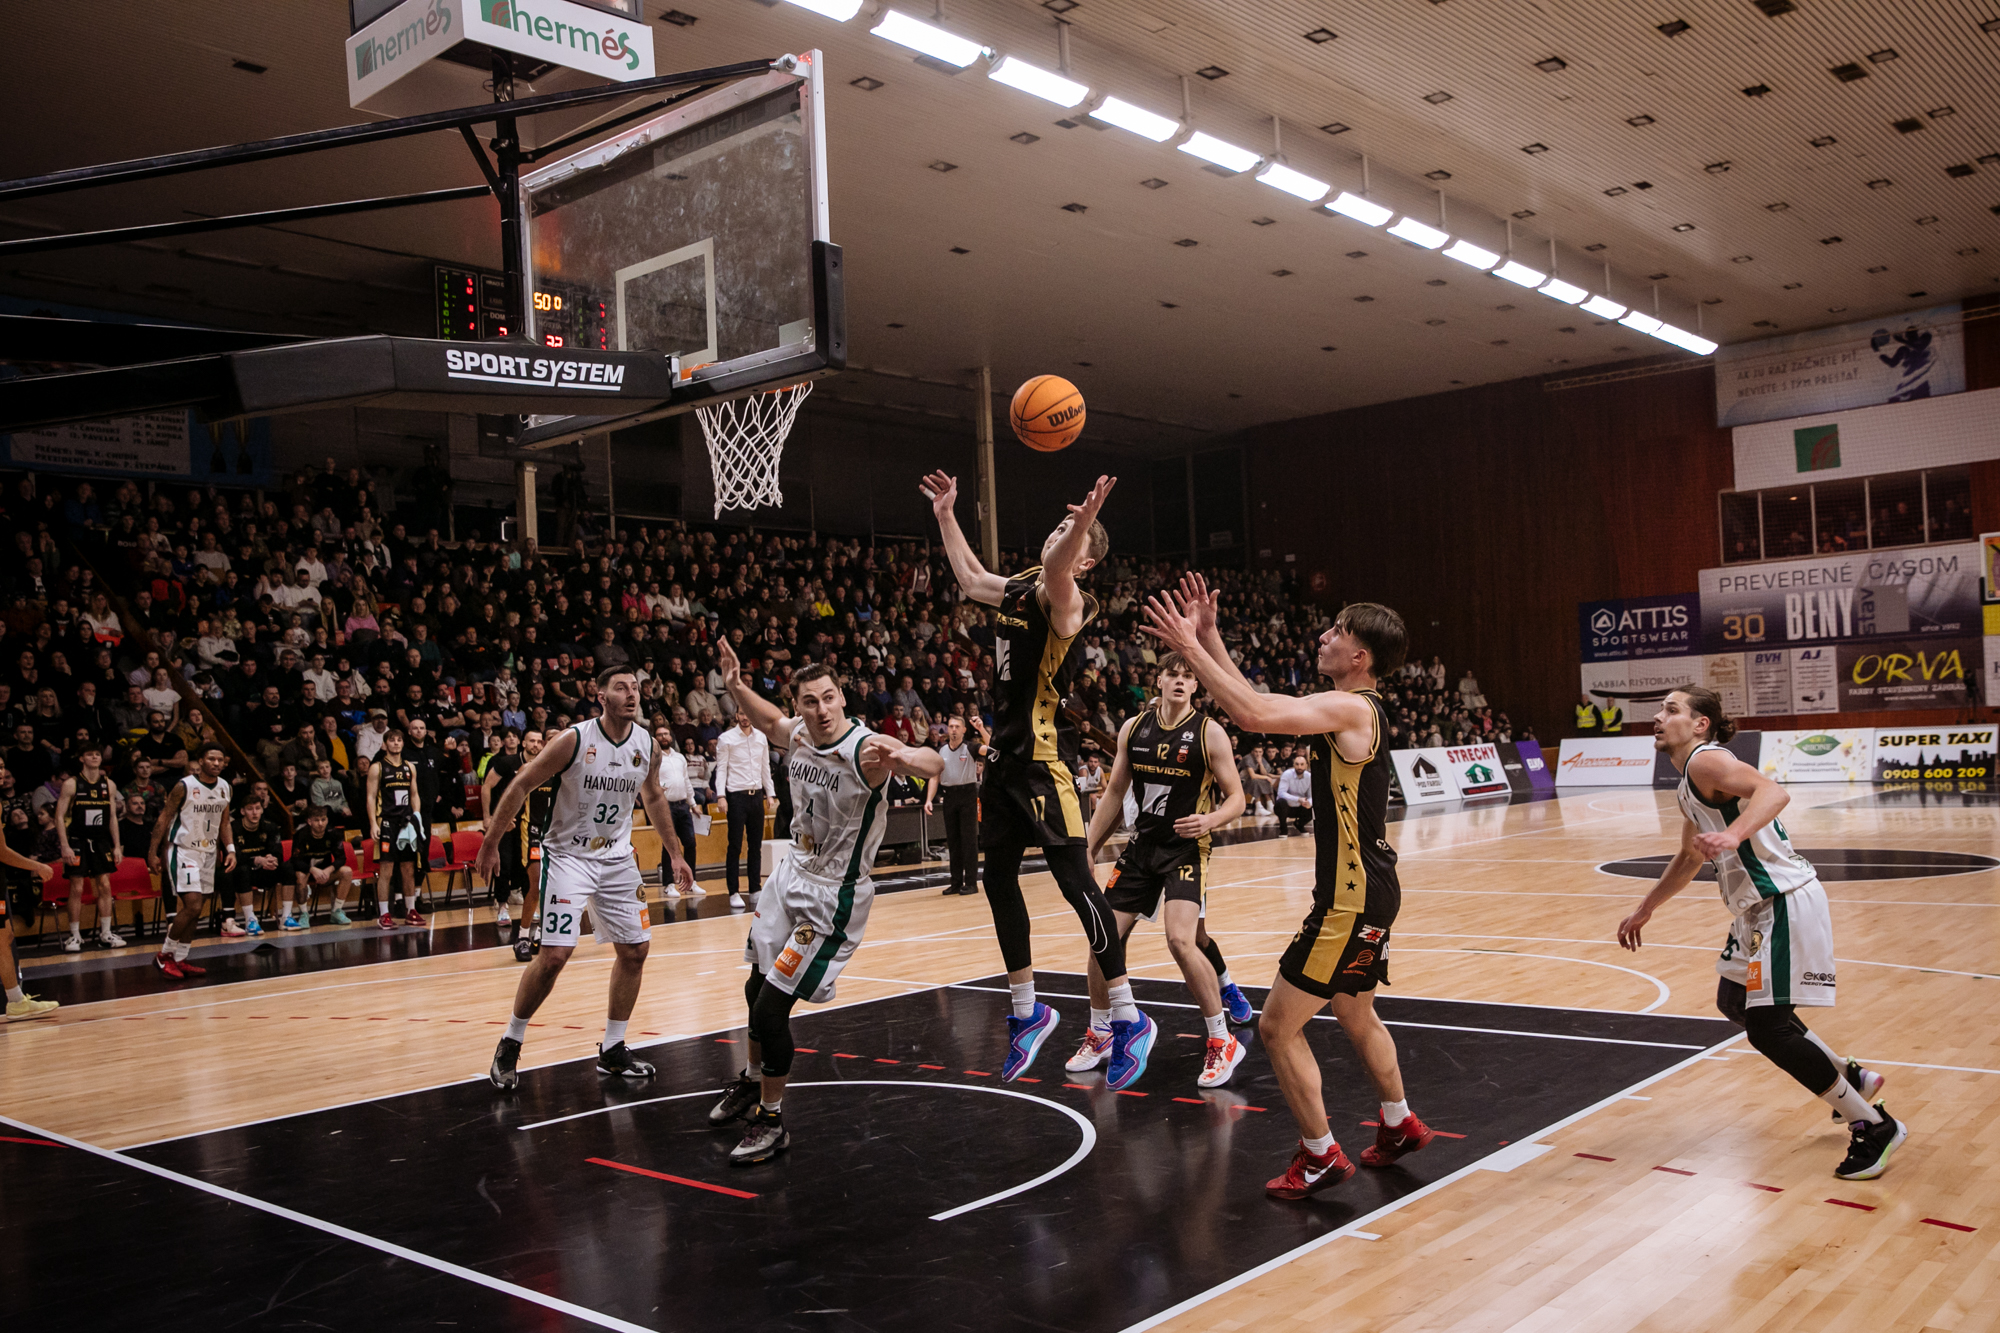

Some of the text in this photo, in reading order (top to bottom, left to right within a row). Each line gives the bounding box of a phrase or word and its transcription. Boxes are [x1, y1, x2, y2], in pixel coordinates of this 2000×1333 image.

[512, 0, 640, 70] hermés
[533, 292, 551, 311] 50
[446, 350, 625, 386] SPORT SYSTEM
[1719, 555, 1960, 594] PREVERENÉ ČASOM
[1618, 605, 1689, 632] ATTIS
[1785, 587, 1854, 641] BENY
[1857, 587, 1877, 636] stav
[1722, 614, 1765, 641] 30
[1592, 630, 1689, 647] SPORTSWEAR
[1755, 652, 1782, 664] BVH
[1801, 650, 1821, 660] AJ
[1852, 649, 1965, 685] ORVA
[1592, 675, 1692, 689] SABBIA RISTORANTE
[1879, 731, 1993, 747] SUPER TAXI
[1156, 743, 1170, 760] 12
[1446, 745, 1496, 764] STRECHY
[1883, 766, 1987, 780] 0908 600 209
[584, 774, 637, 793] HANDLOVÁ
[593, 803, 620, 824] 32
[207, 820, 211, 832] 1
[187, 872, 191, 885] 1
[1178, 864, 1195, 882] 12
[545, 912, 573, 934] 32
